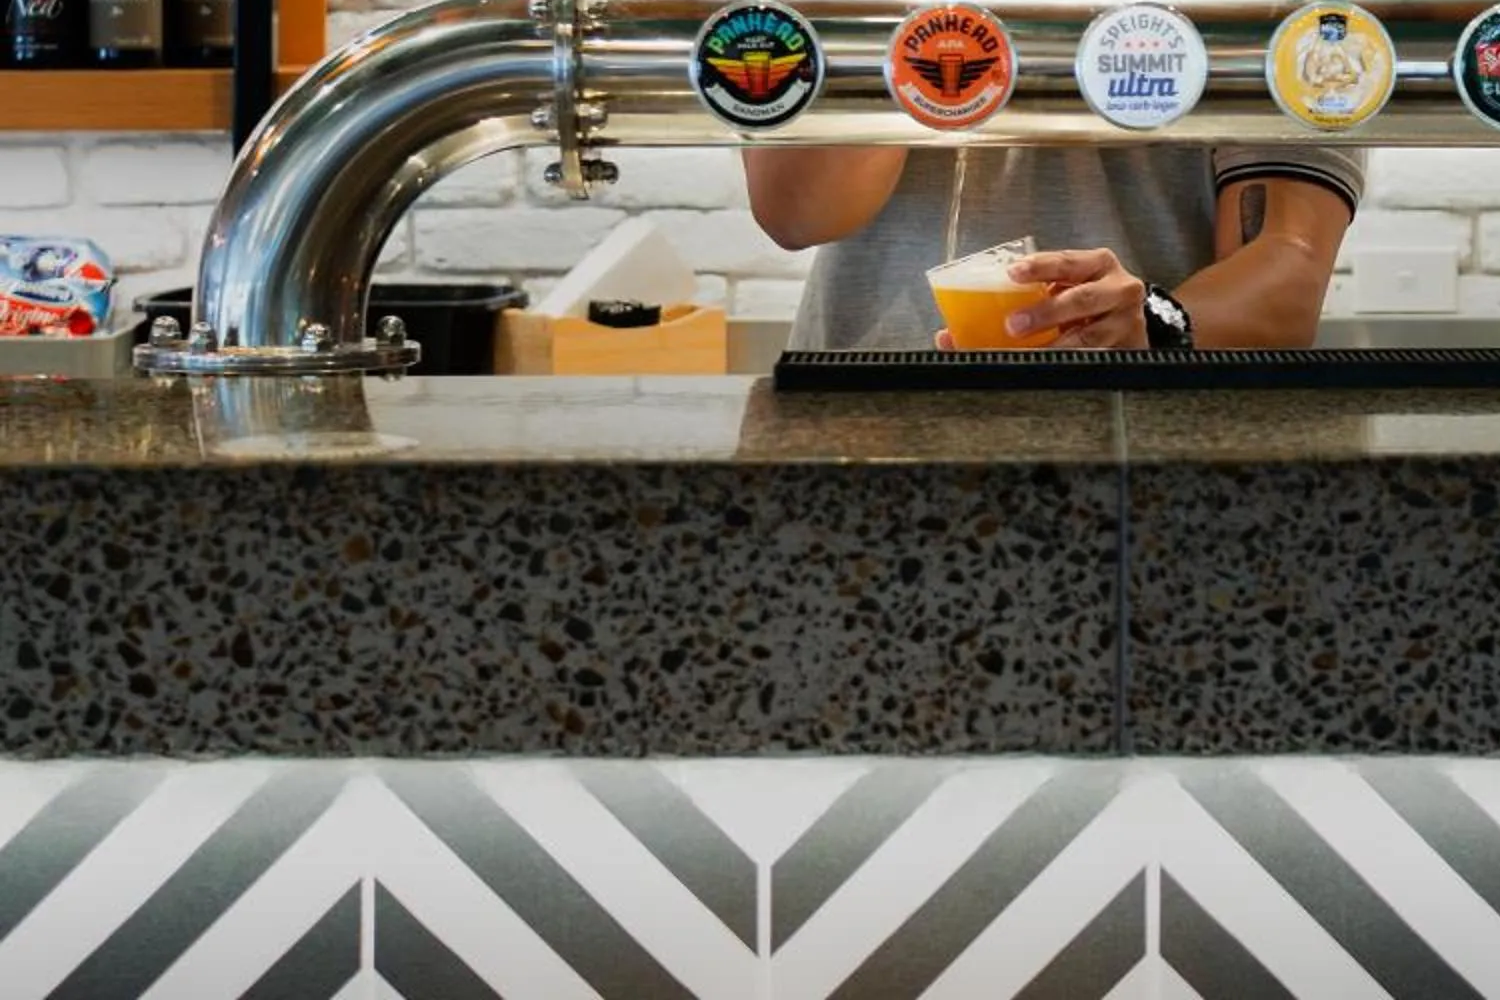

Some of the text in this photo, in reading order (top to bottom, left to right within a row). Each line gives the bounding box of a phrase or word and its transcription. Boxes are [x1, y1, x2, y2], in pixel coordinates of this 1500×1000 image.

[708, 13, 805, 54] PANHEAD
[904, 14, 998, 53] PANHEAD
[1097, 53, 1186, 73] SUMMIT
[1108, 71, 1179, 97] ultra
